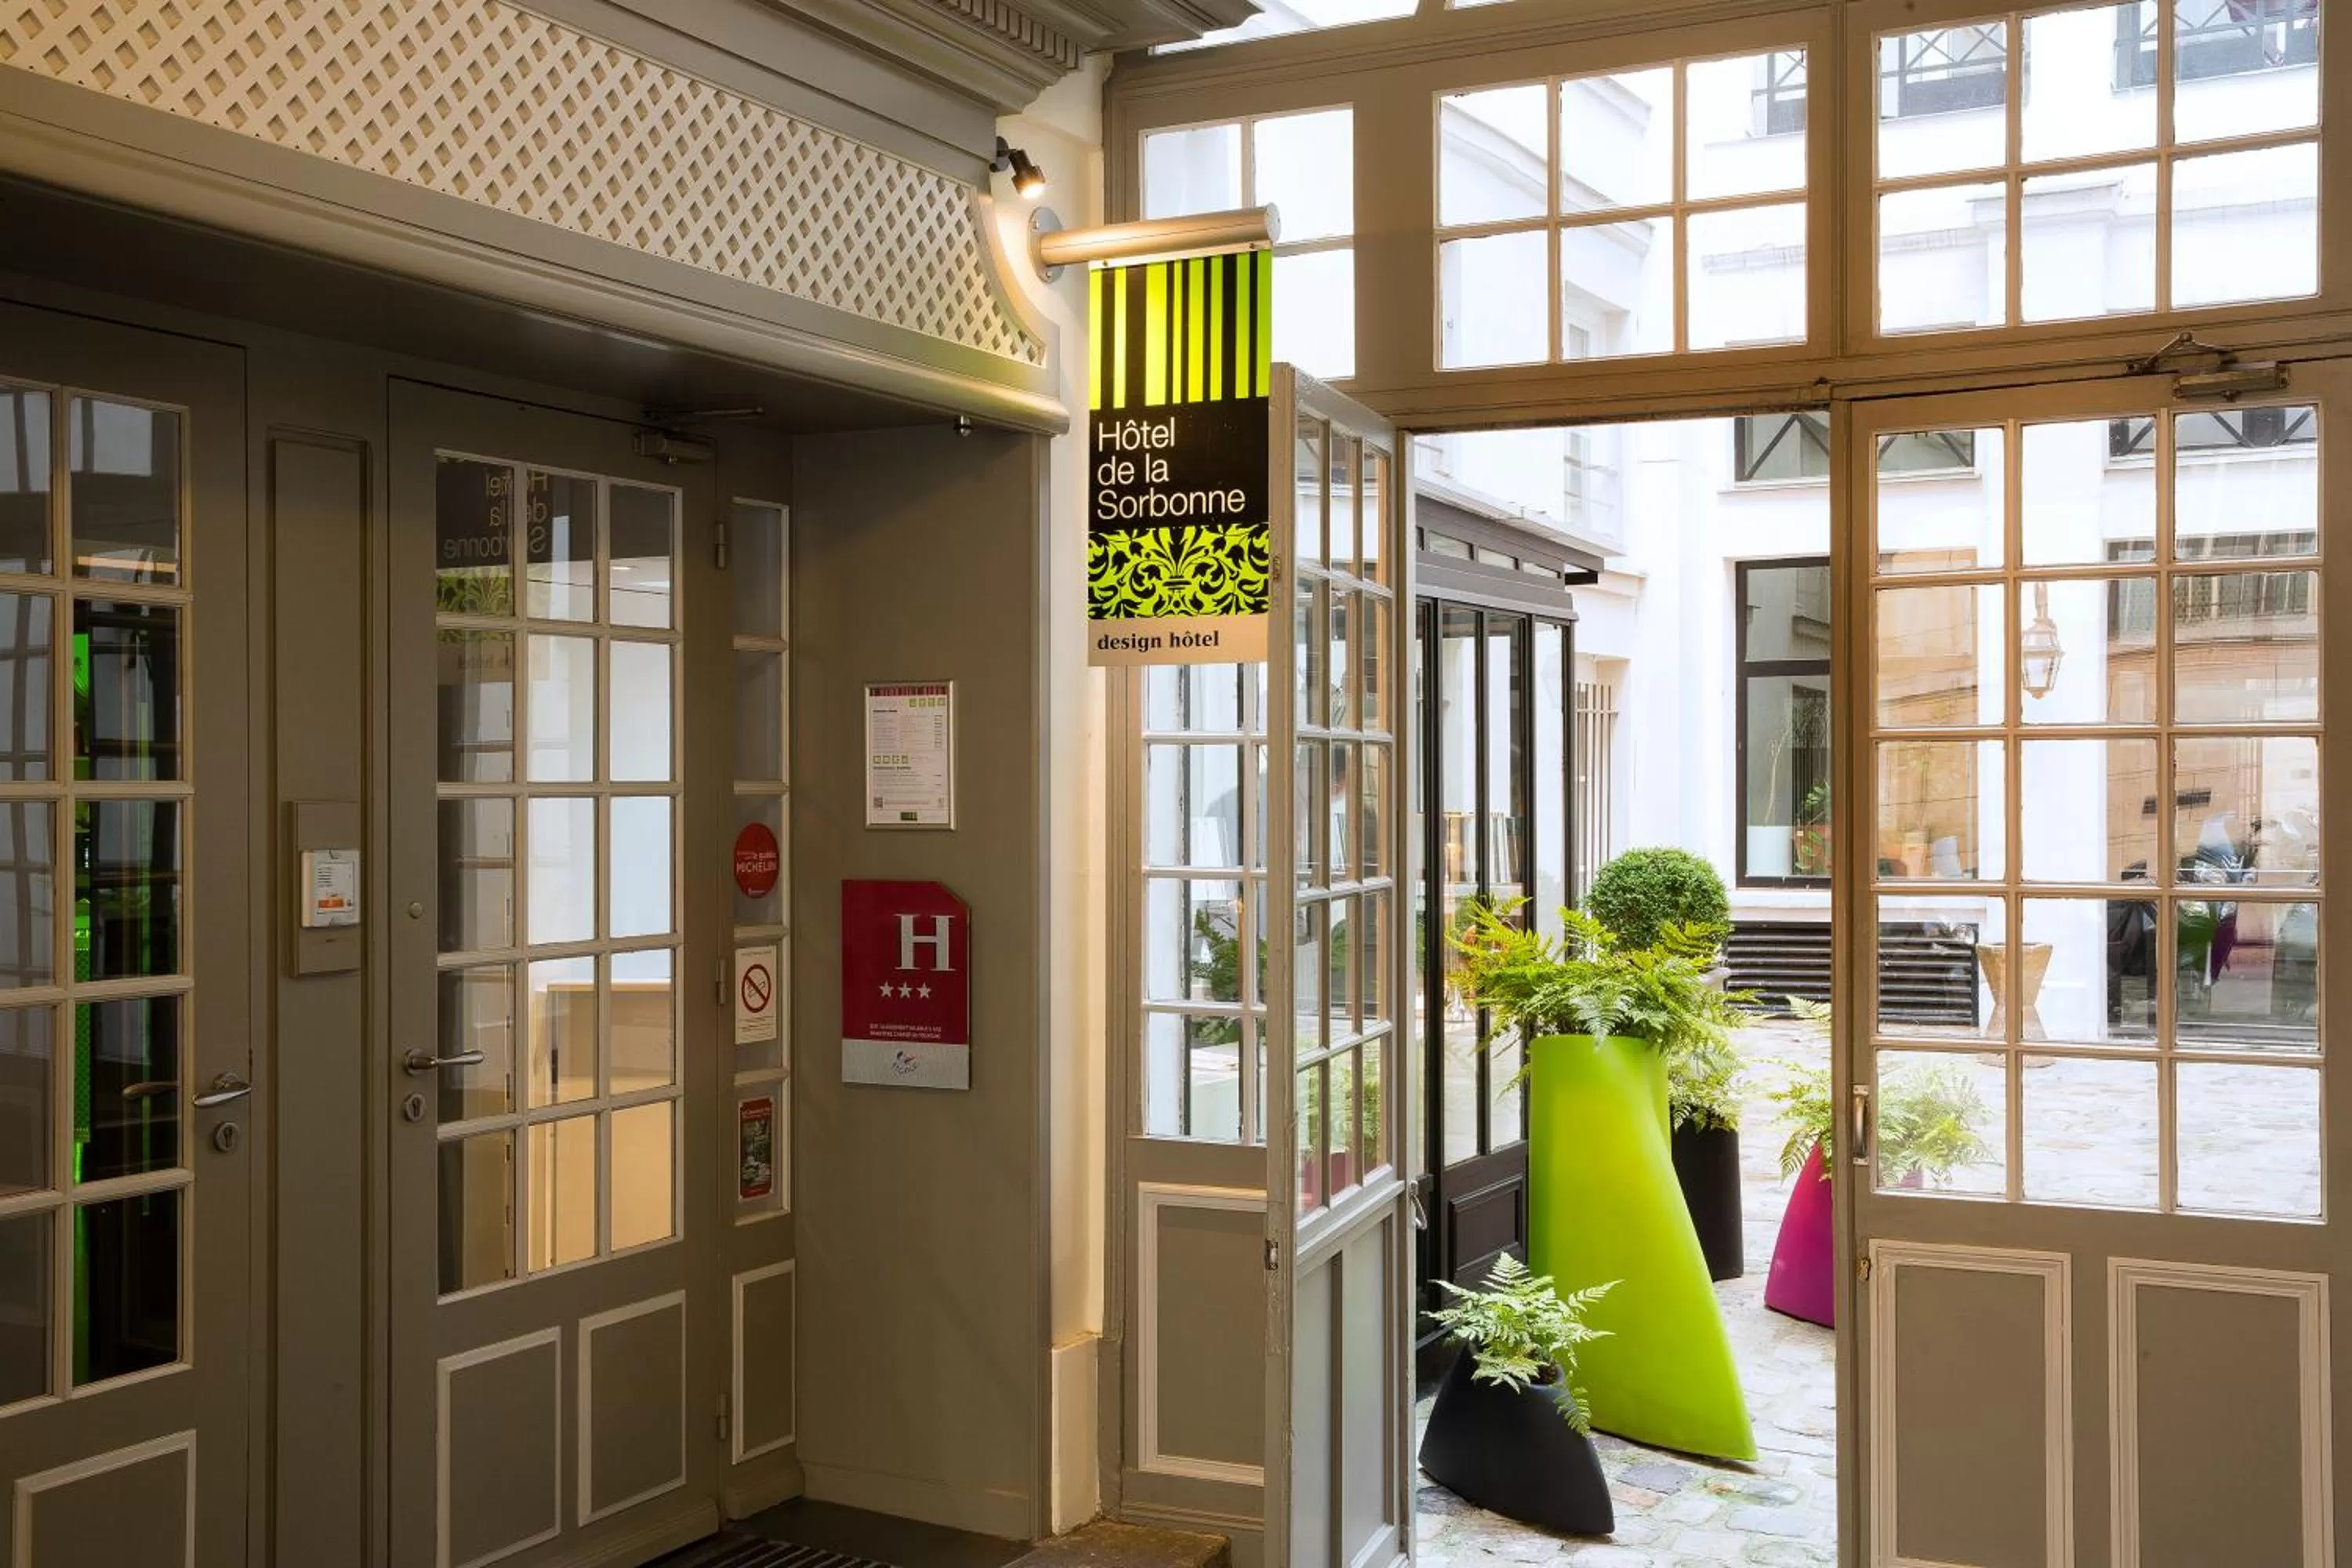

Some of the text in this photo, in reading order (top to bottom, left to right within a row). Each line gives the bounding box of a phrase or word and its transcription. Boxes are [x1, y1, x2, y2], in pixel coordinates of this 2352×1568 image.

[1098, 417, 1175, 452] Hôtel
[1098, 453, 1170, 485] de la
[1098, 487, 1245, 520] Sorbonne
[1098, 630, 1220, 652] design hôtel
[894, 913, 957, 971] H
